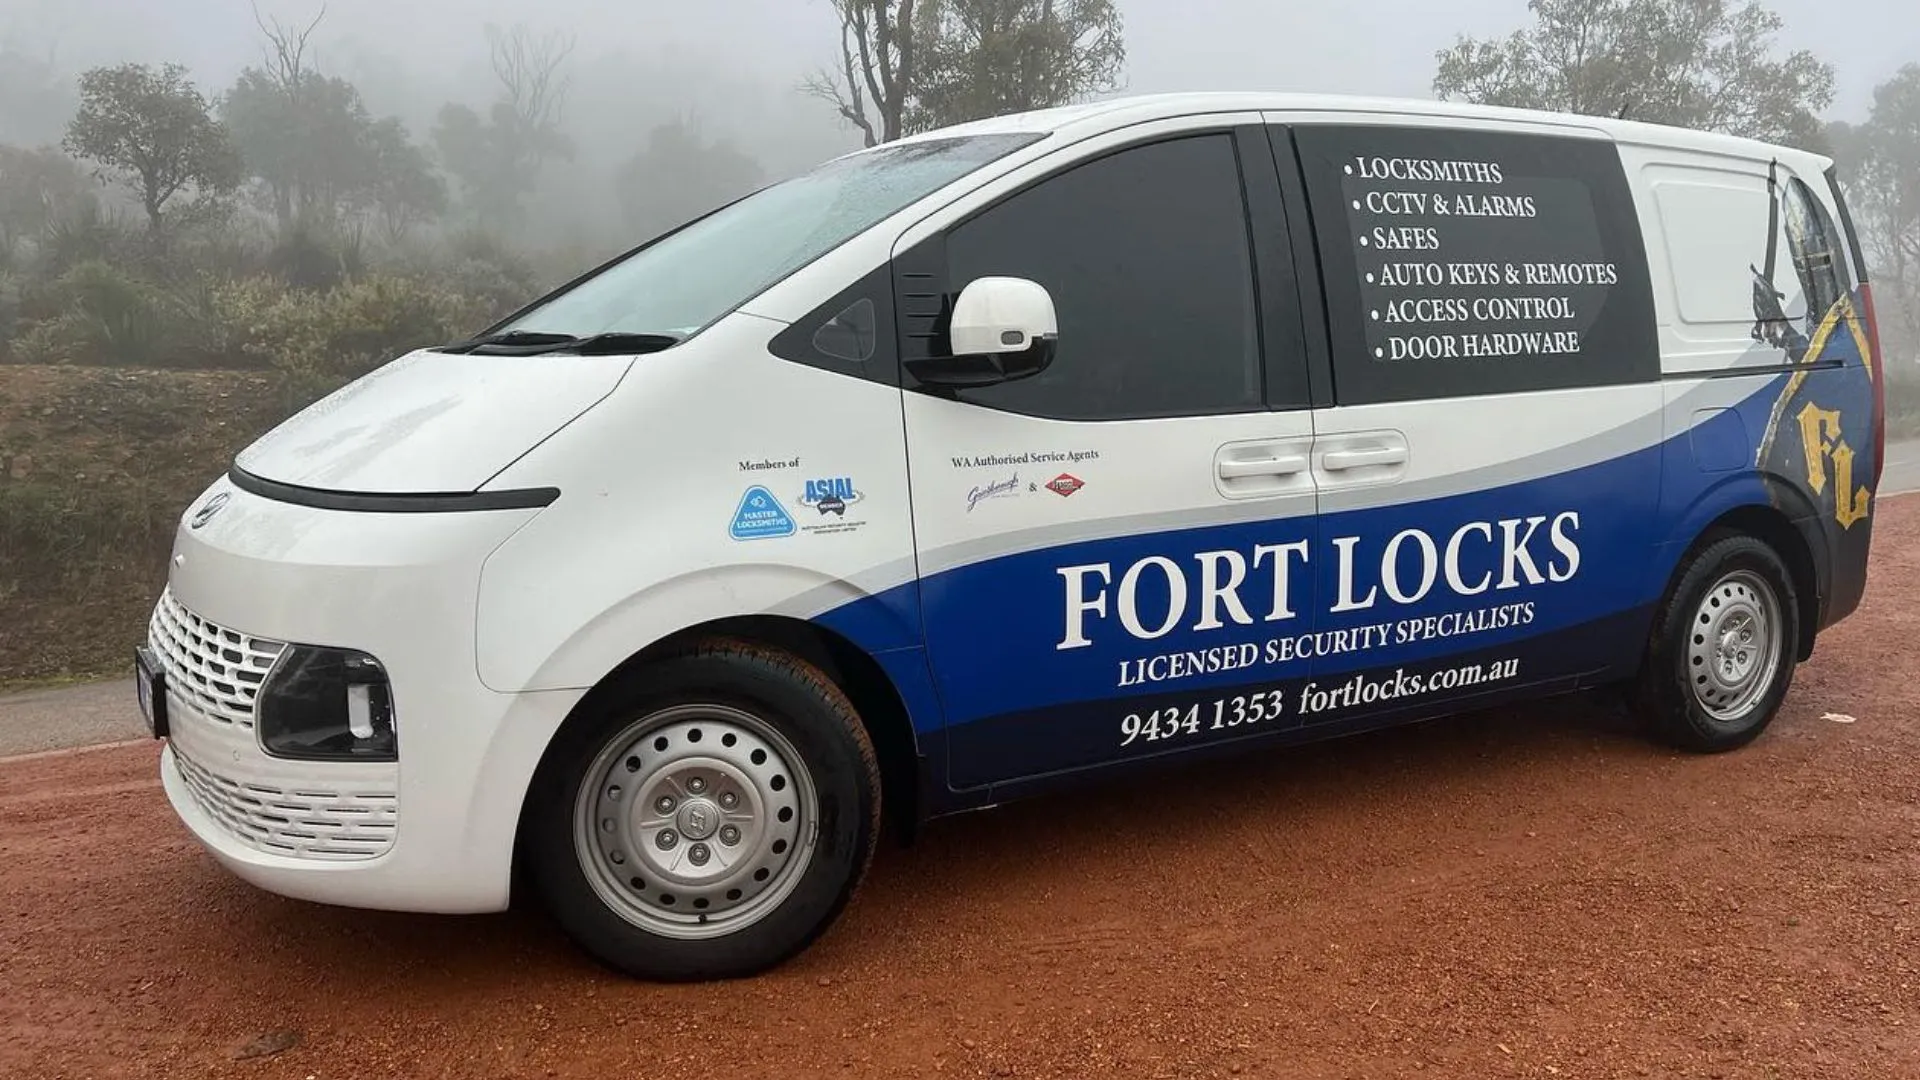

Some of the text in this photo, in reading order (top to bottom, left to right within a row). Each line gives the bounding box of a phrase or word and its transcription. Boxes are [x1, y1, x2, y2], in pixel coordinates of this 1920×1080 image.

[1356, 157, 1503, 184] LOCKSMITHS
[1366, 192, 1536, 218] CCTV & ALARMS
[1373, 227, 1440, 250] SAFES
[1380, 263, 1618, 286] AUTO KEYS & REMOTES
[1385, 297, 1576, 322] ACCESS CONTROL
[1389, 331, 1580, 360] DOOR HARDWARE
[738, 457, 800, 471] Members of
[952, 449, 1099, 468] WA Authorised Service Agents
[805, 477, 856, 502] ASIAL
[1029, 482, 1037, 492] &
[736, 518, 788, 529] LOCKSMITHS
[743, 510, 778, 520] MASTER
[1057, 512, 1579, 649] FORT LOCKS
[1118, 602, 1534, 686] LICENSED SECURITY SPECIALISTS
[1121, 659, 1518, 746] 9434 1353 fortlocks.com.au
